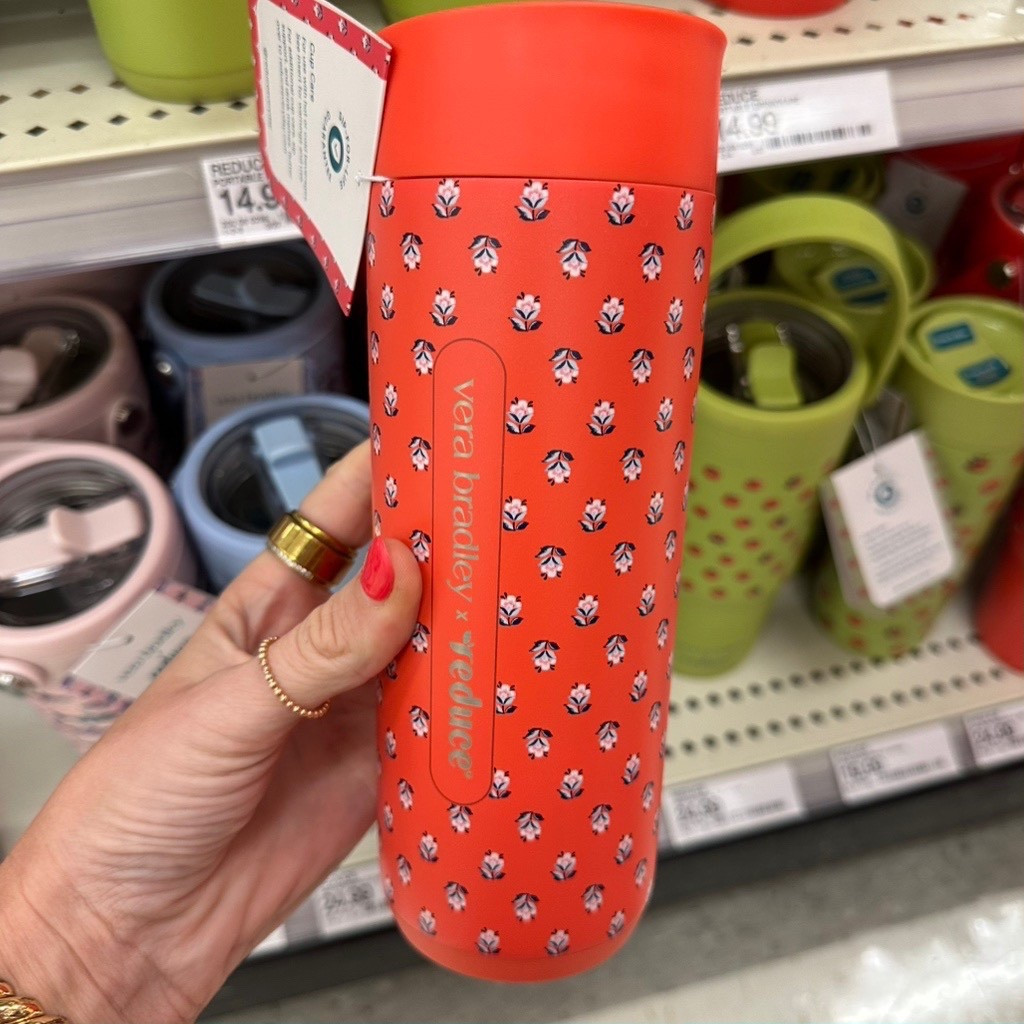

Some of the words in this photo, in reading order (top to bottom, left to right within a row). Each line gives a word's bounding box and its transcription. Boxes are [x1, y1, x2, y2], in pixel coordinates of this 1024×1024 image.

[211, 158, 263, 174] REDUC
[220, 183, 279, 216] 14.9
[453, 378, 475, 459] vera
[447, 471, 480, 602] bradley
[455, 609, 469, 622] x
[448, 633, 483, 773] reduce
